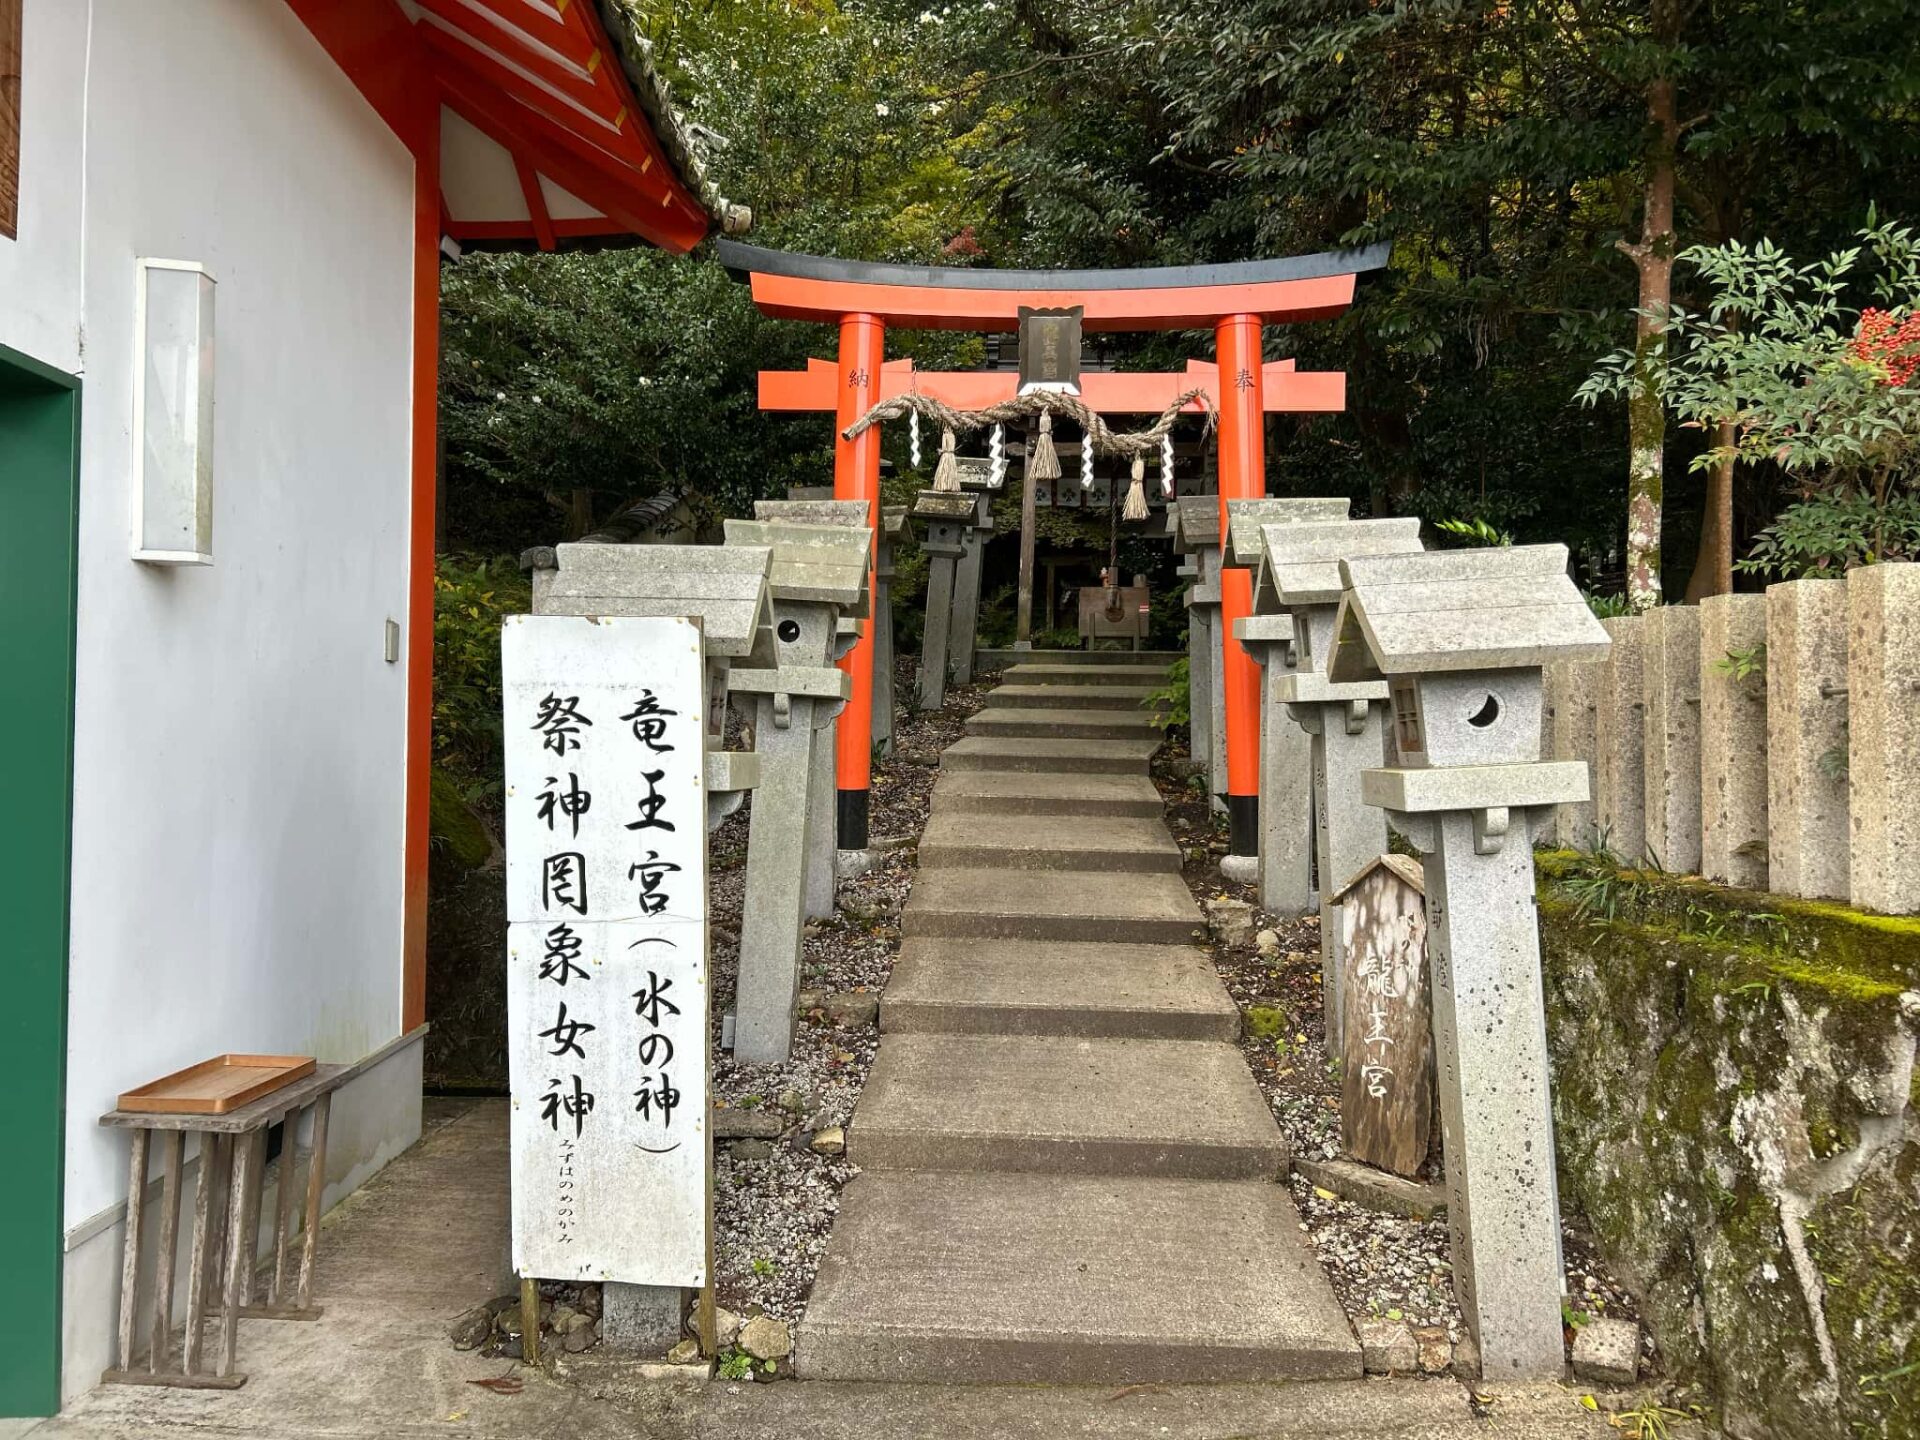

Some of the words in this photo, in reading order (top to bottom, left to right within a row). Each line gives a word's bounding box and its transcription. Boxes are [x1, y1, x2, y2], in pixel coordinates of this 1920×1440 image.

[849, 368, 869, 388] 納
[1233, 368, 1256, 393] 奉
[1356, 951, 1400, 1099] 龍王宮
